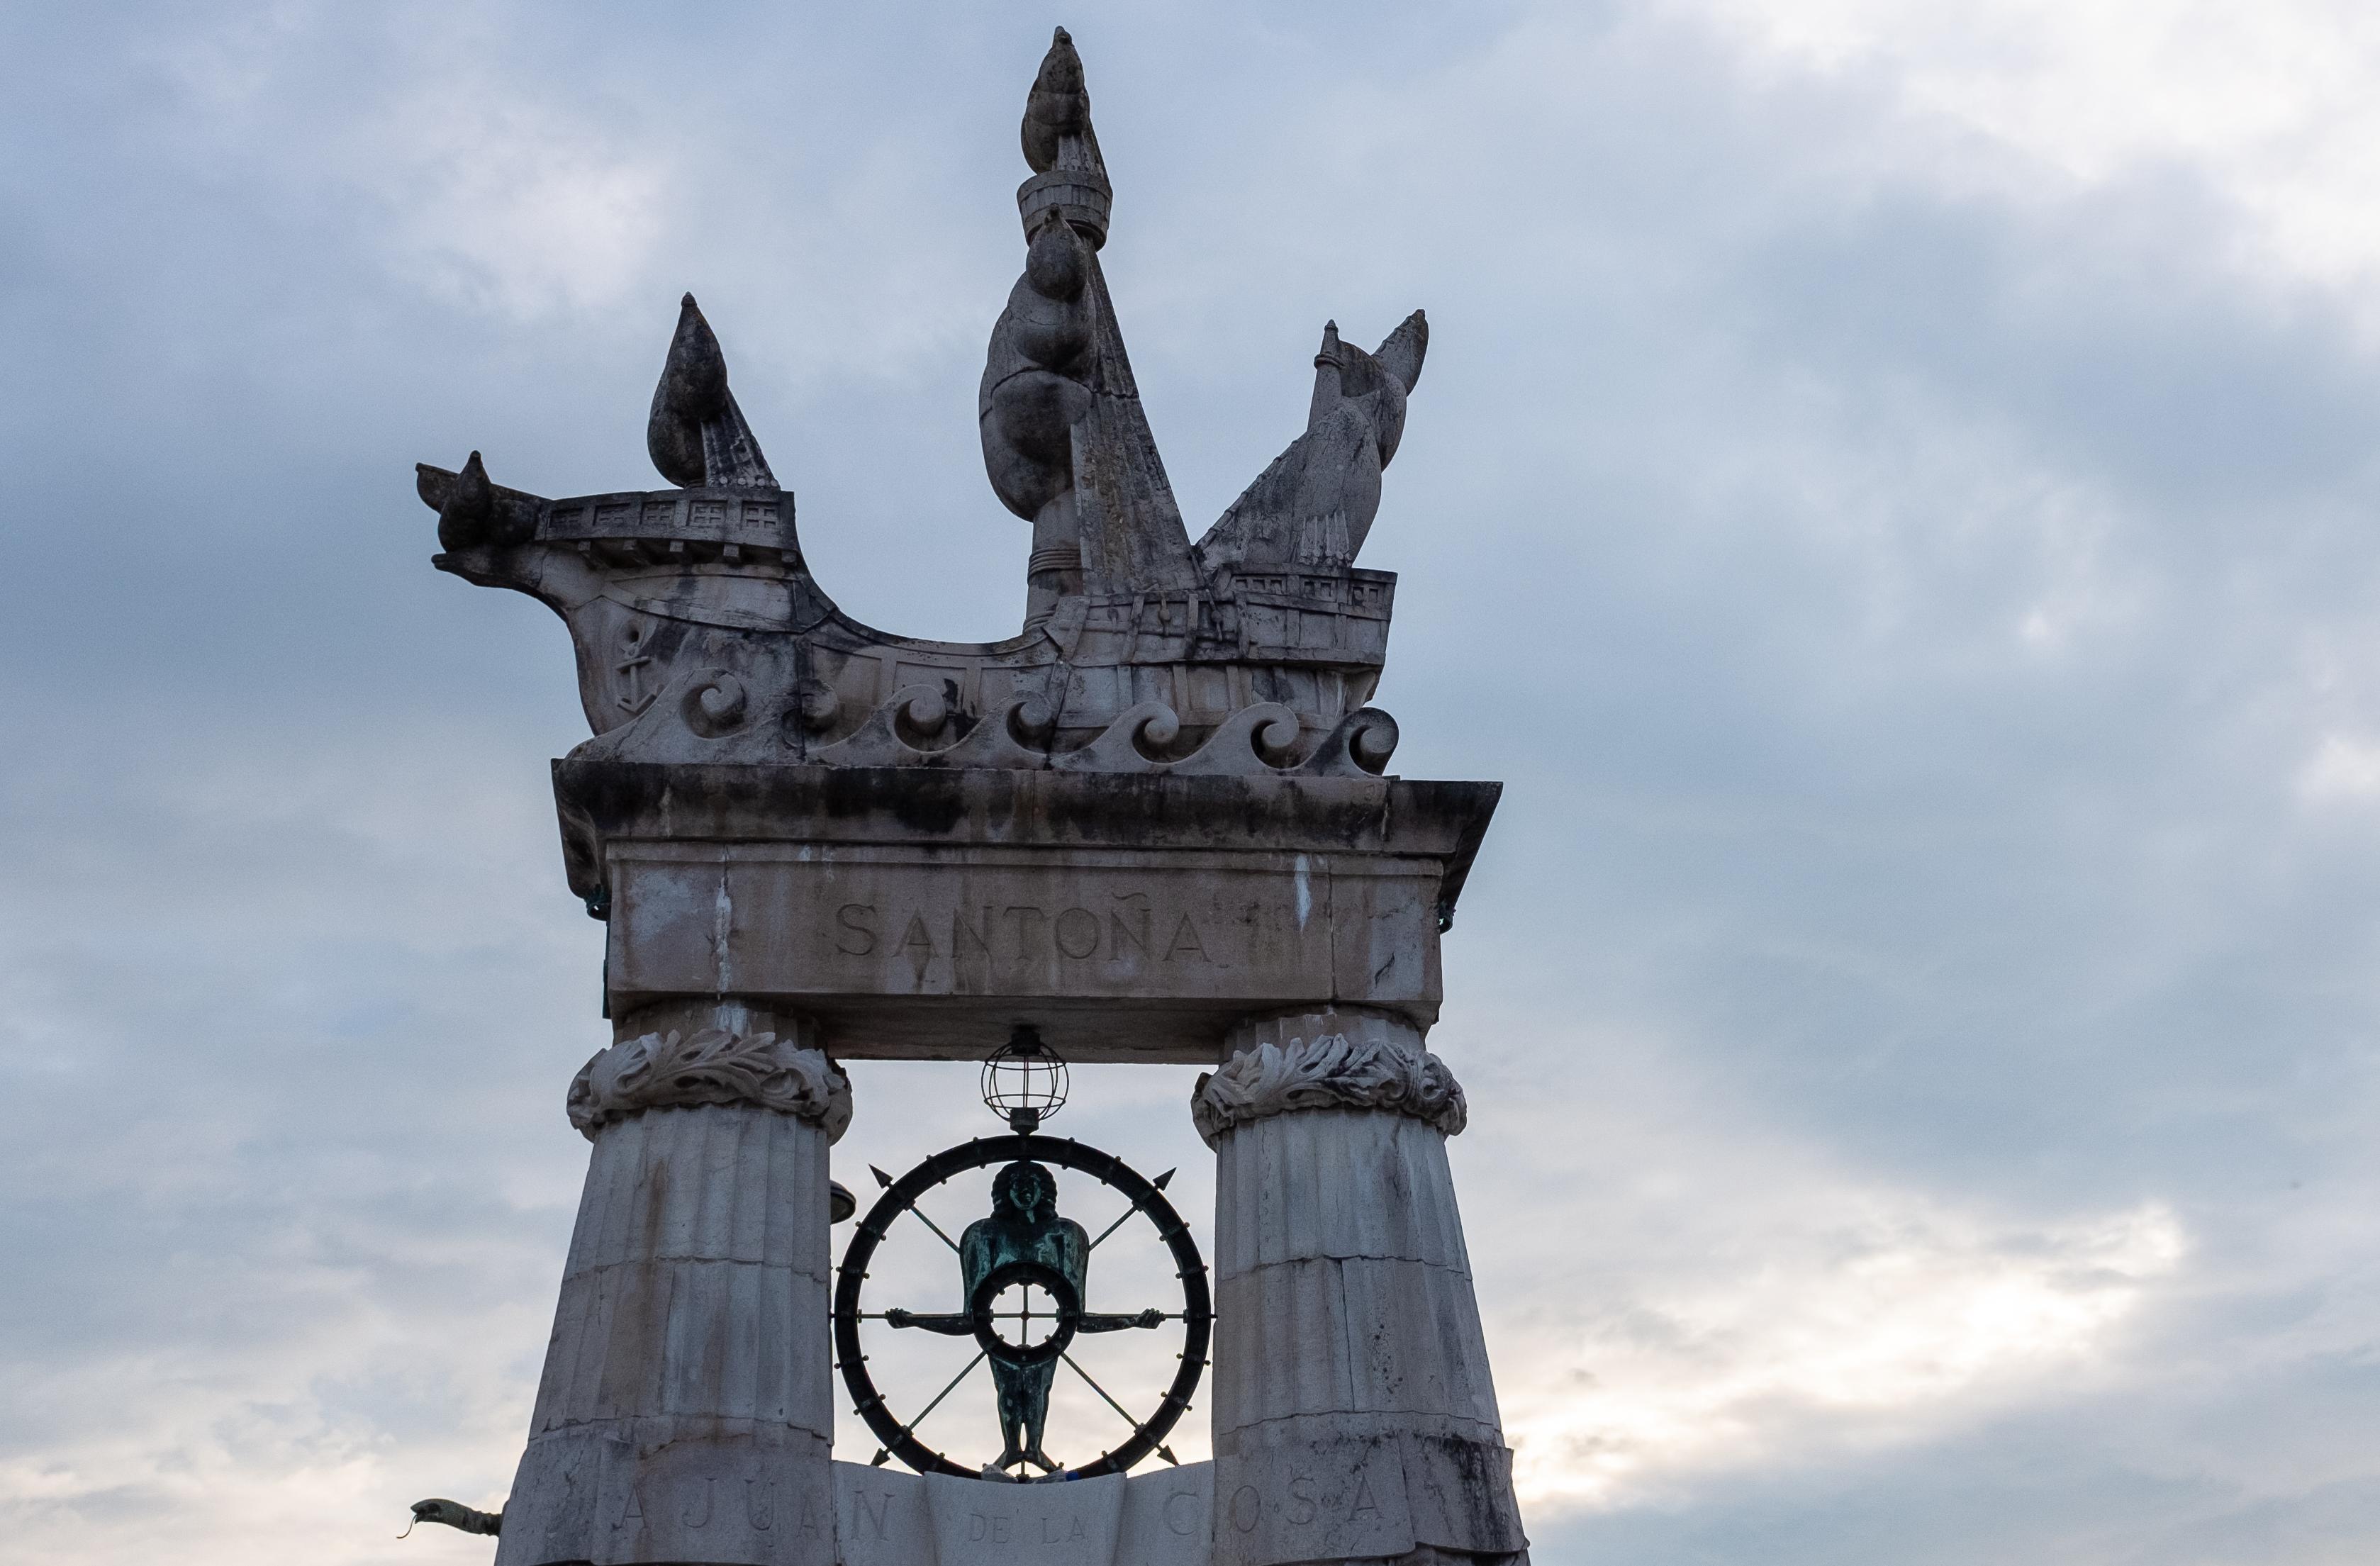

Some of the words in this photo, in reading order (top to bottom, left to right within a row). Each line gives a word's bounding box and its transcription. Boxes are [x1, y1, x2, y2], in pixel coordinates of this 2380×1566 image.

[834, 891, 1212, 963] SANTOÑA
[612, 1479, 649, 1530] A
[681, 1477, 896, 1541] JUAN
[968, 1513, 1010, 1545] DE
[1040, 1515, 1087, 1545] LA
[1162, 1473, 1387, 1536] COSA
